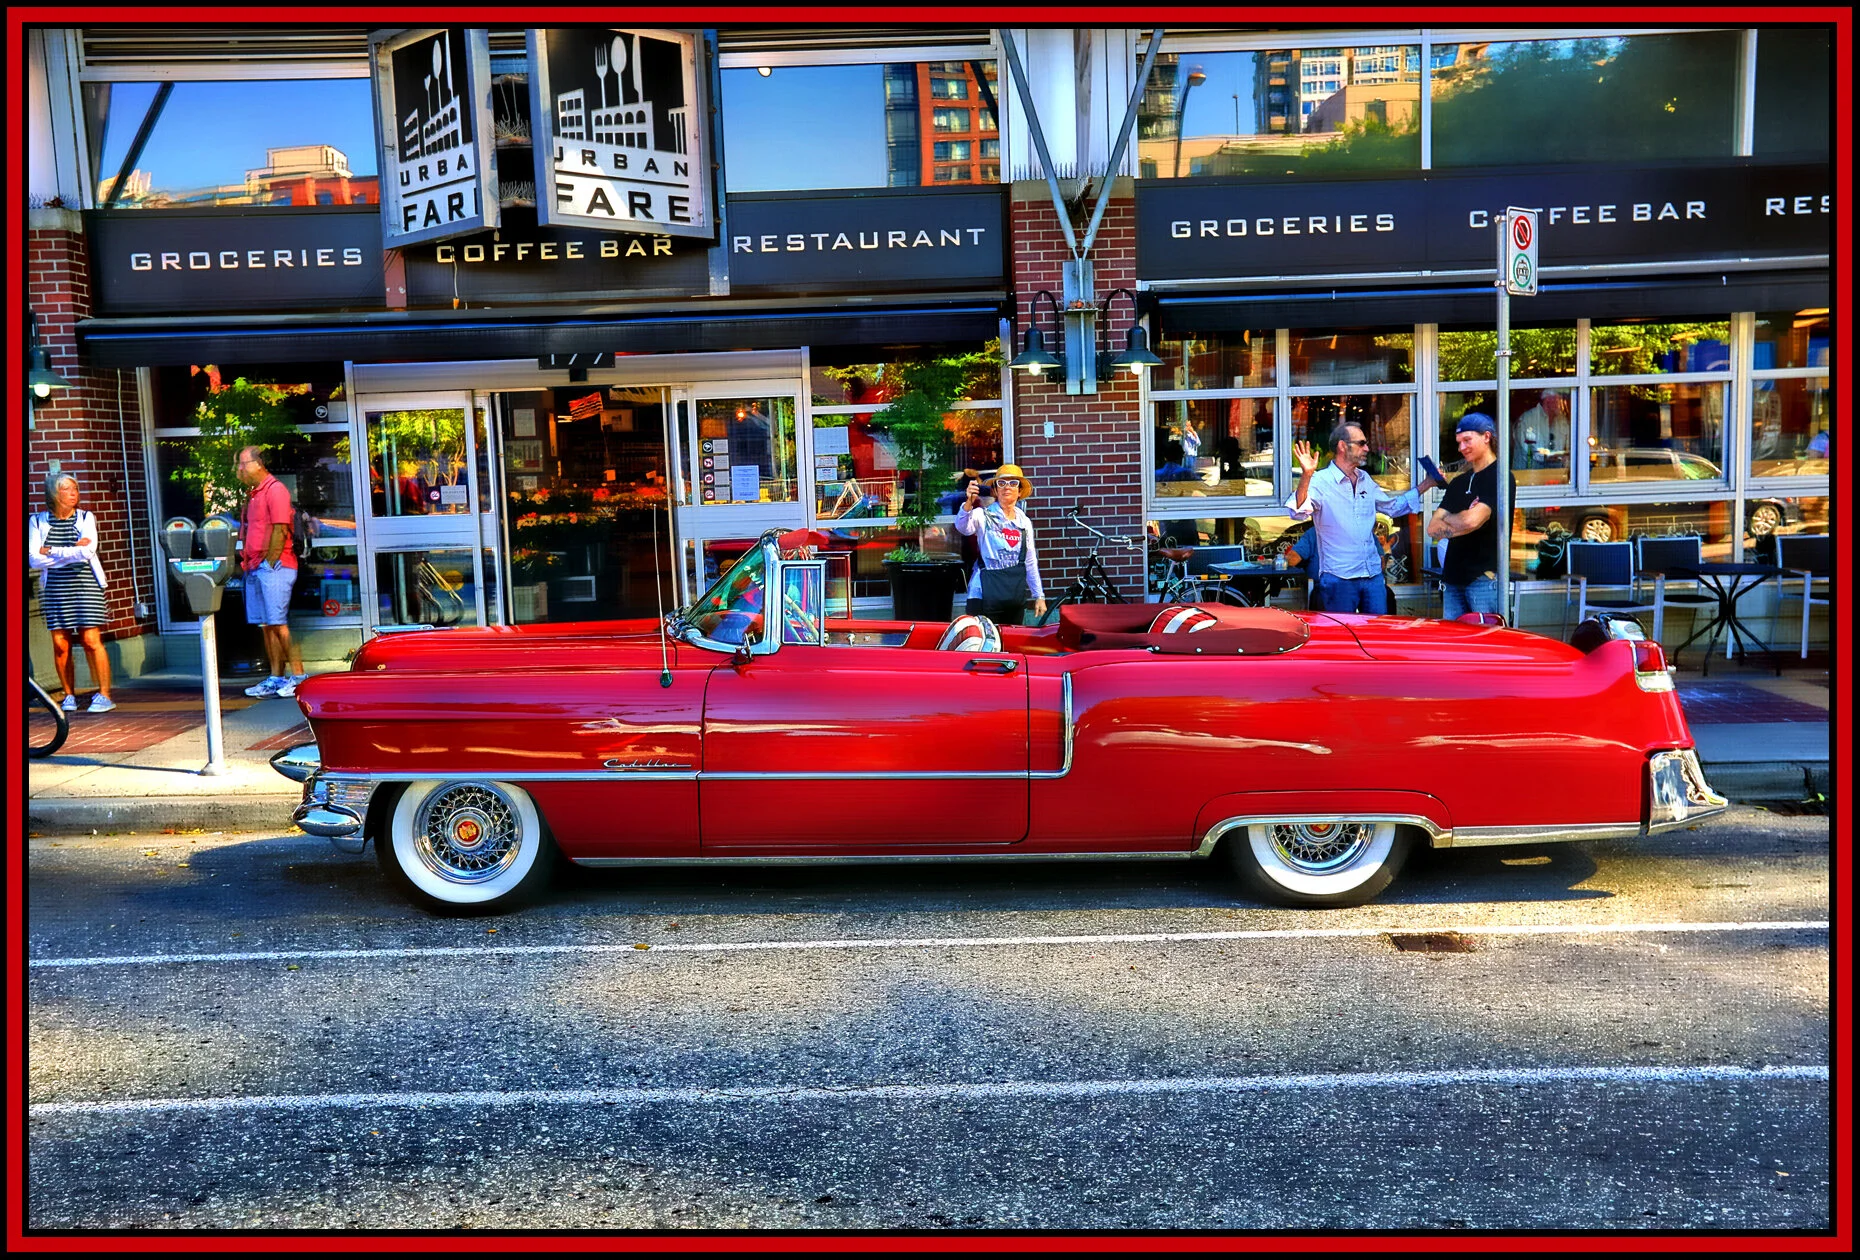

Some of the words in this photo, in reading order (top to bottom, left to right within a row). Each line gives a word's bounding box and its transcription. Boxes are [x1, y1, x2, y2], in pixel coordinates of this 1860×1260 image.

[400, 154, 469, 186] URBA
[554, 146, 690, 178] URBAN
[402, 188, 478, 232] FAR
[556, 182, 691, 223] FARE
[1469, 204, 1617, 229] CFEE
[1632, 200, 1706, 222] BAR
[1171, 213, 1395, 238] GROCERIES
[437, 241, 585, 263] COFFEE
[600, 239, 673, 258] BAR
[733, 228, 986, 254] RESTAURANT
[131, 248, 362, 271] GROCERIES
[603, 758, 692, 768] Cadillac
